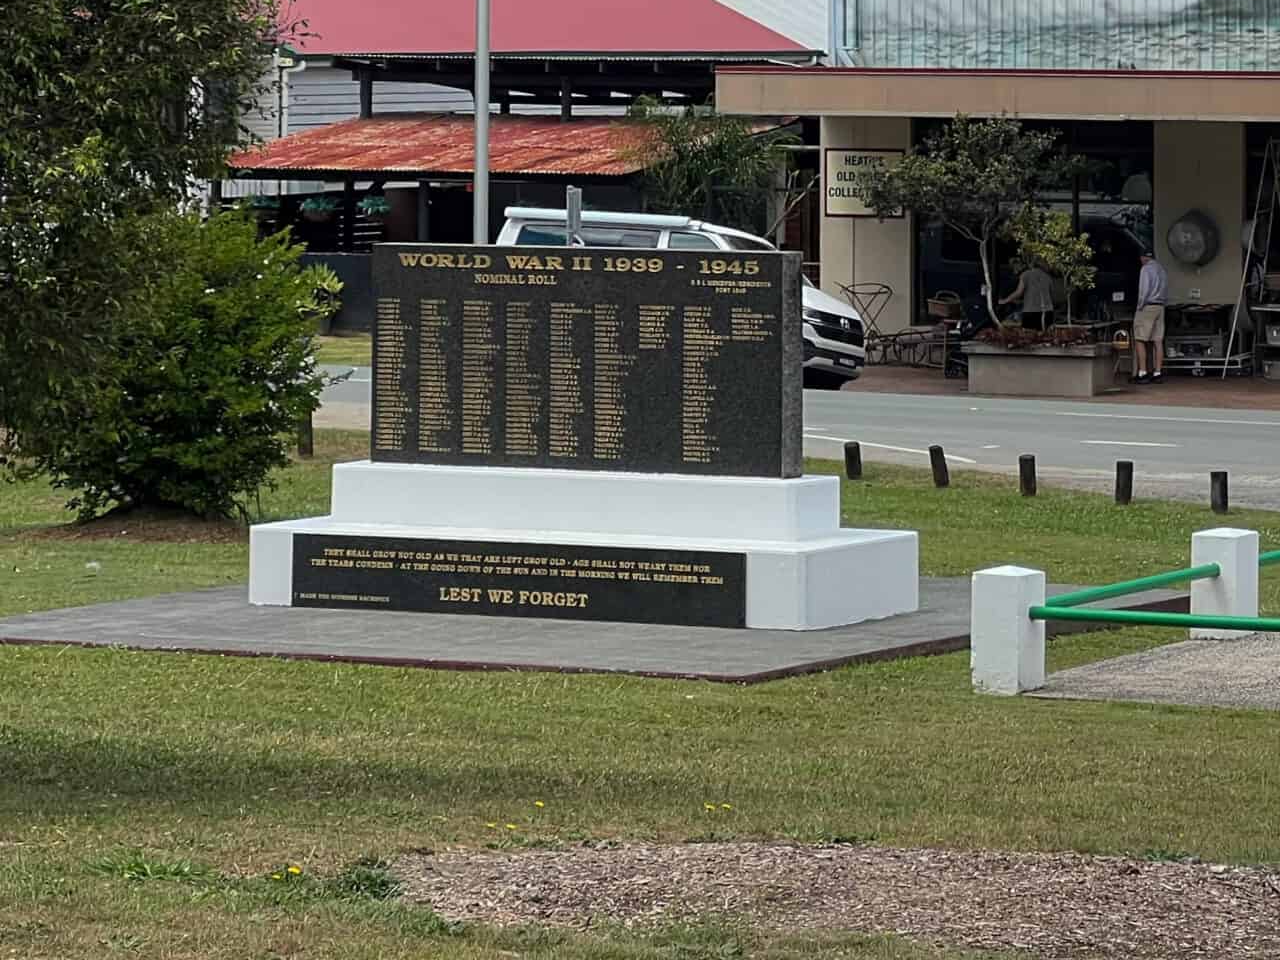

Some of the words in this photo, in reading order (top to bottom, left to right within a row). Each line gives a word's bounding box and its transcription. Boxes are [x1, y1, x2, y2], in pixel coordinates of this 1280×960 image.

[837, 171, 856, 181] OLD
[398, 252, 491, 269] WORLD
[505, 255, 565, 271] WAR
[572, 256, 592, 271] II
[603, 256, 664, 273] 1939
[698, 259, 760, 275] 1945
[474, 273, 526, 284] NOMINAL
[528, 274, 557, 285] ROLL
[416, 552, 432, 560] OLD
[461, 553, 482, 562] THAT
[549, 557, 566, 566] OLD
[439, 587, 481, 602] LEST
[488, 589, 514, 604] WE
[519, 591, 589, 608] FORGET
